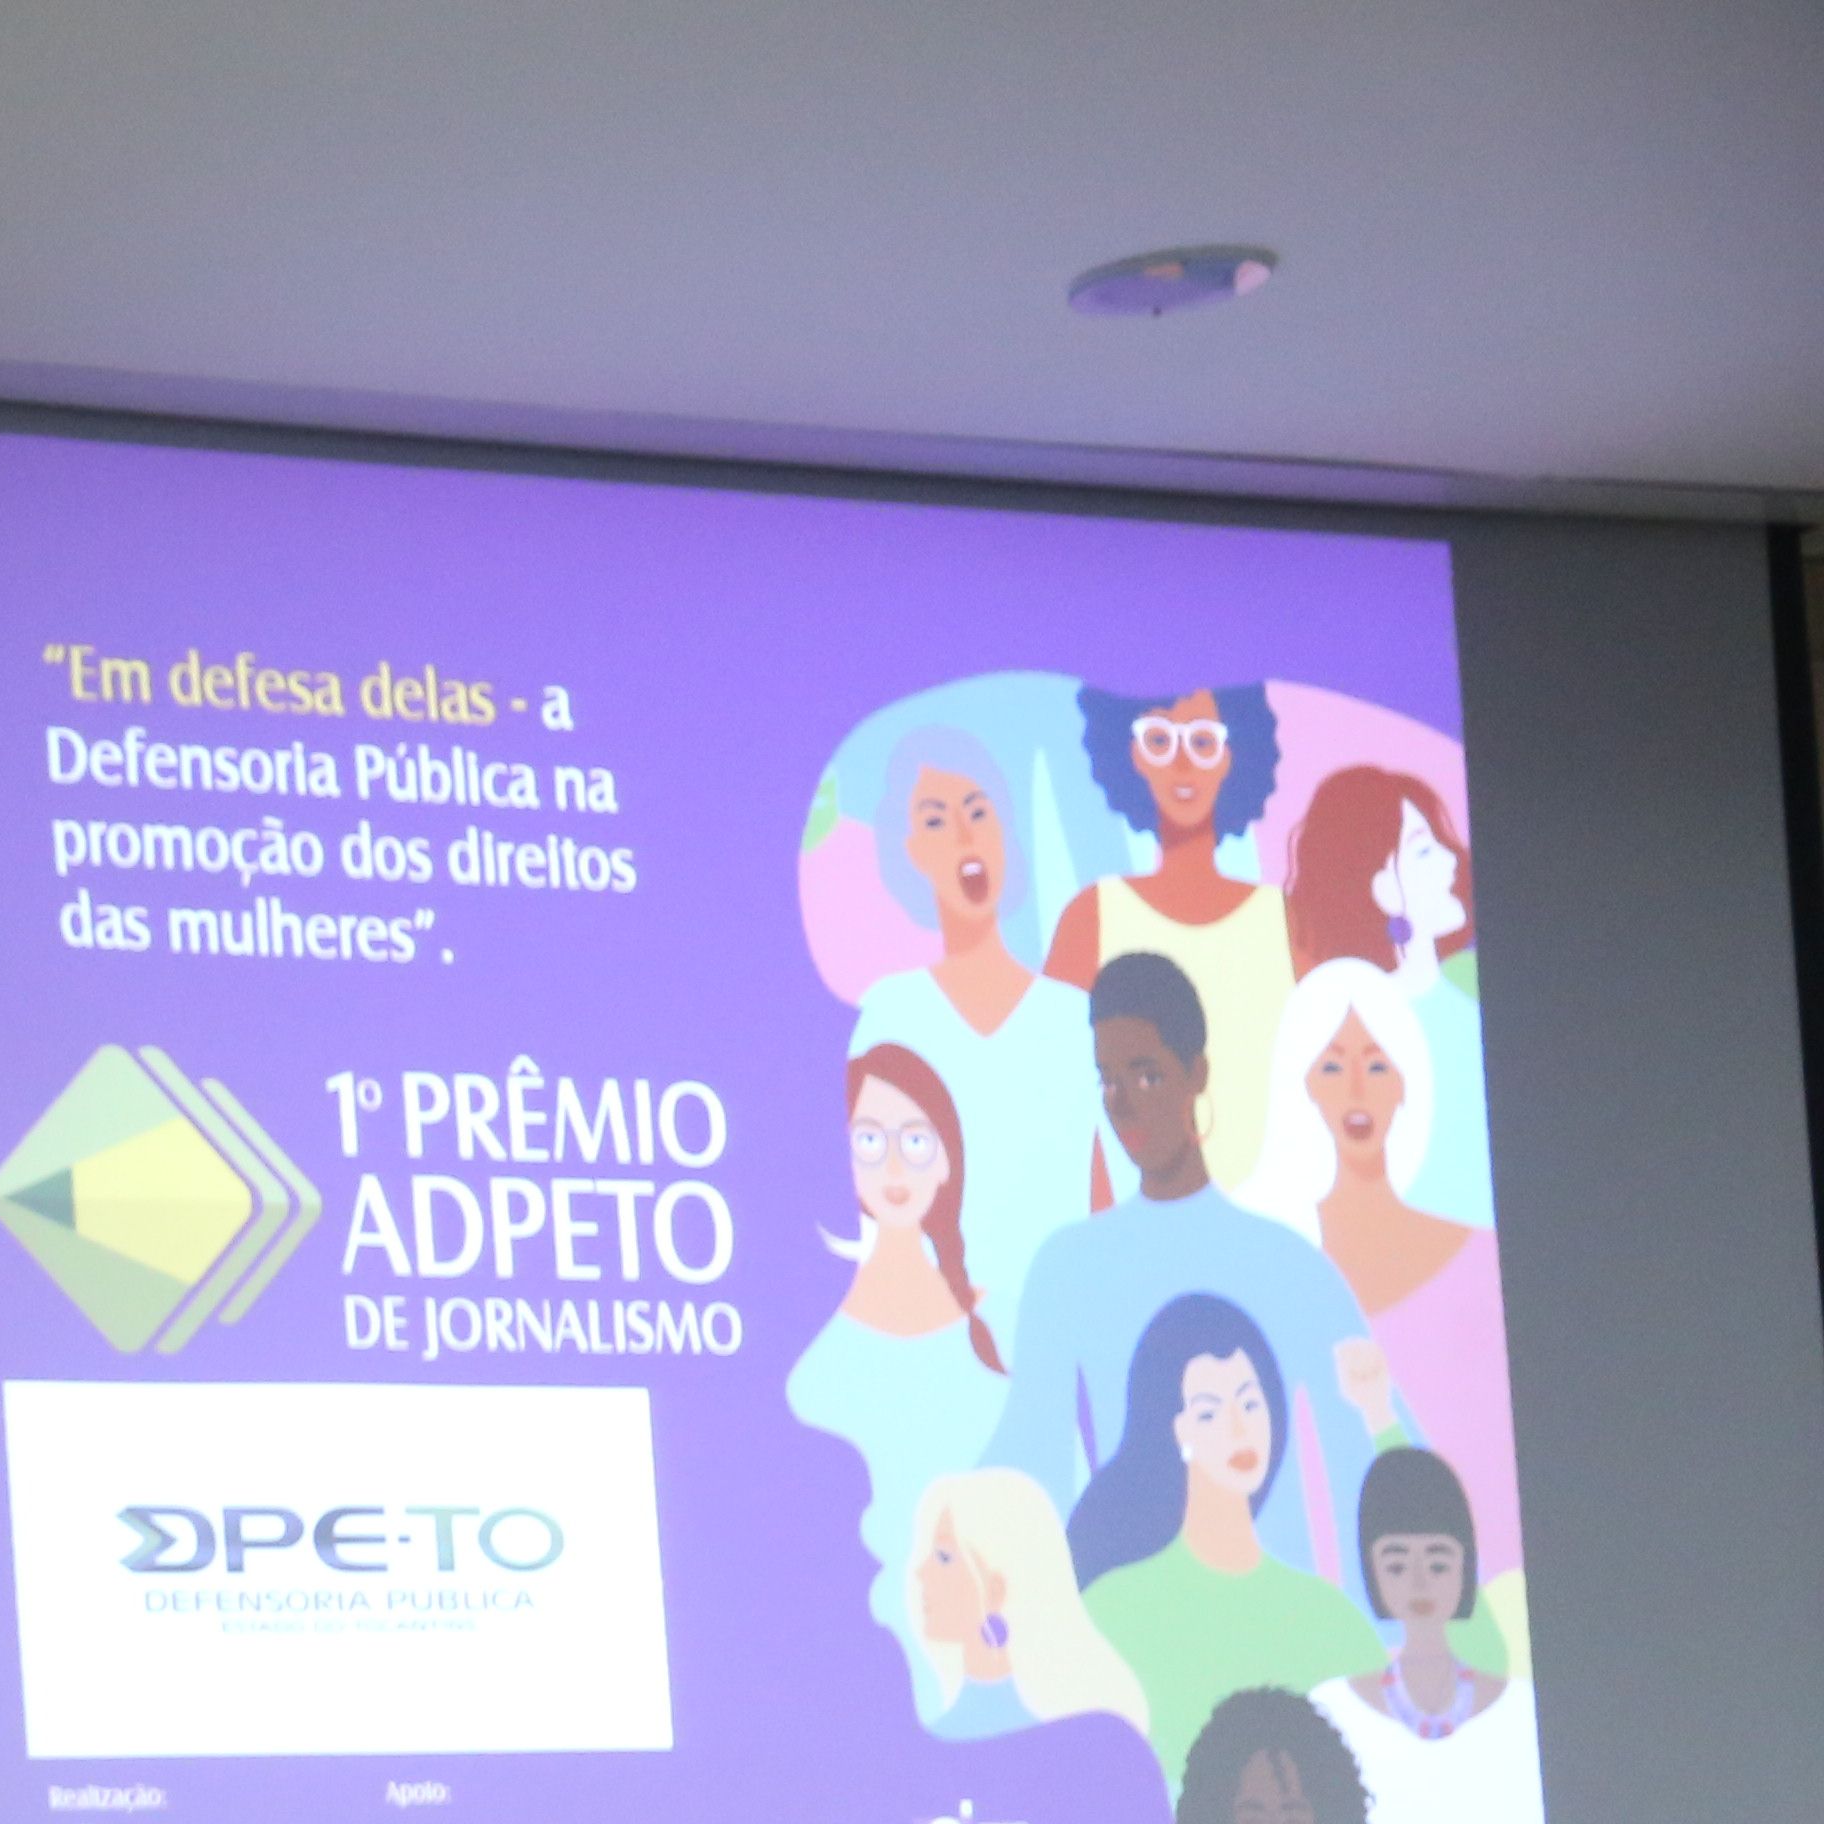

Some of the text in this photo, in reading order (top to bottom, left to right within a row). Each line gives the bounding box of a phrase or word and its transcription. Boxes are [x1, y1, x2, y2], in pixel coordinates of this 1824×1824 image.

[170, 648, 344, 718] defesa
[361, 662, 496, 725] delas
[541, 684, 574, 731] a
[46, 725, 619, 815] Defensoria Pública na
[52, 815, 637, 894] promoção dos direitos
[60, 890, 150, 952] das
[402, 1054, 728, 1168] PRÊMIO
[342, 1173, 735, 1284] ADPETO
[343, 1294, 743, 1361] DE JORNALISMO
[144, 1589, 371, 1614] DEFENSORIA
